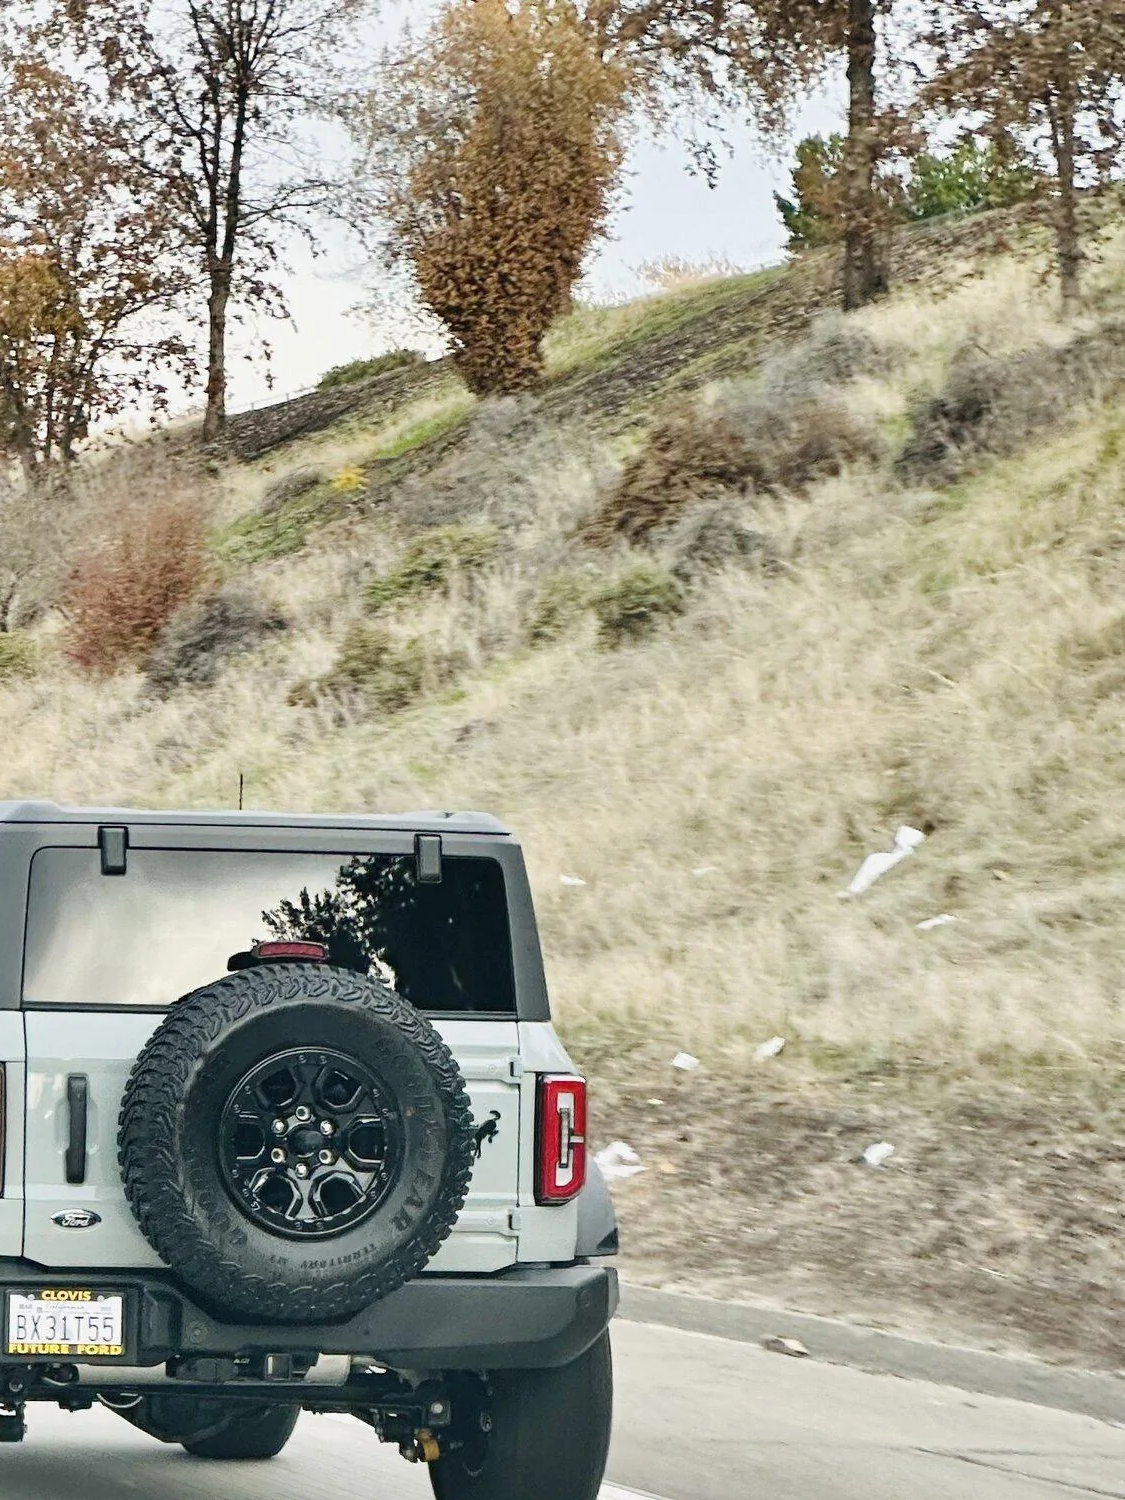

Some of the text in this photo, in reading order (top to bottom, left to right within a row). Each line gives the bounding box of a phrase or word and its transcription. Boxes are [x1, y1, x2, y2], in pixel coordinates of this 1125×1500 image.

[41, 1290, 91, 1301] CLOVIS
[16, 1314, 115, 1342] BX31T55
[8, 1343, 123, 1356] FUTURE FORD
